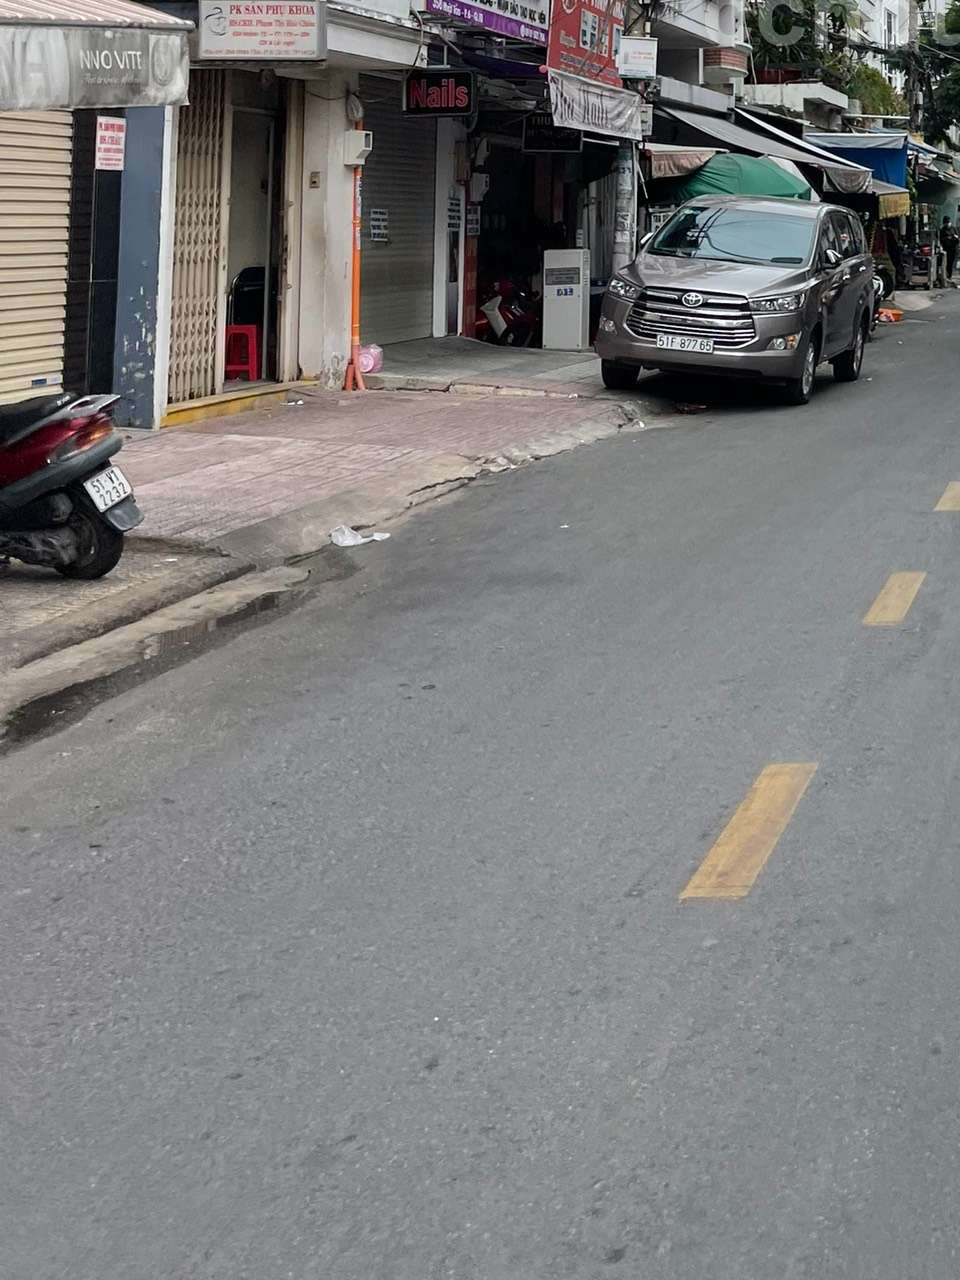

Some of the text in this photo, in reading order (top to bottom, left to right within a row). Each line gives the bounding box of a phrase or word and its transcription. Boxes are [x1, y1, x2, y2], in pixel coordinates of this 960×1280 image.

[229, 5, 242, 15] PK
[288, 4, 315, 15] KHOA
[408, 78, 469, 109] Nails
[658, 336, 676, 347] 51F
[100, 482, 128, 506] 2232
